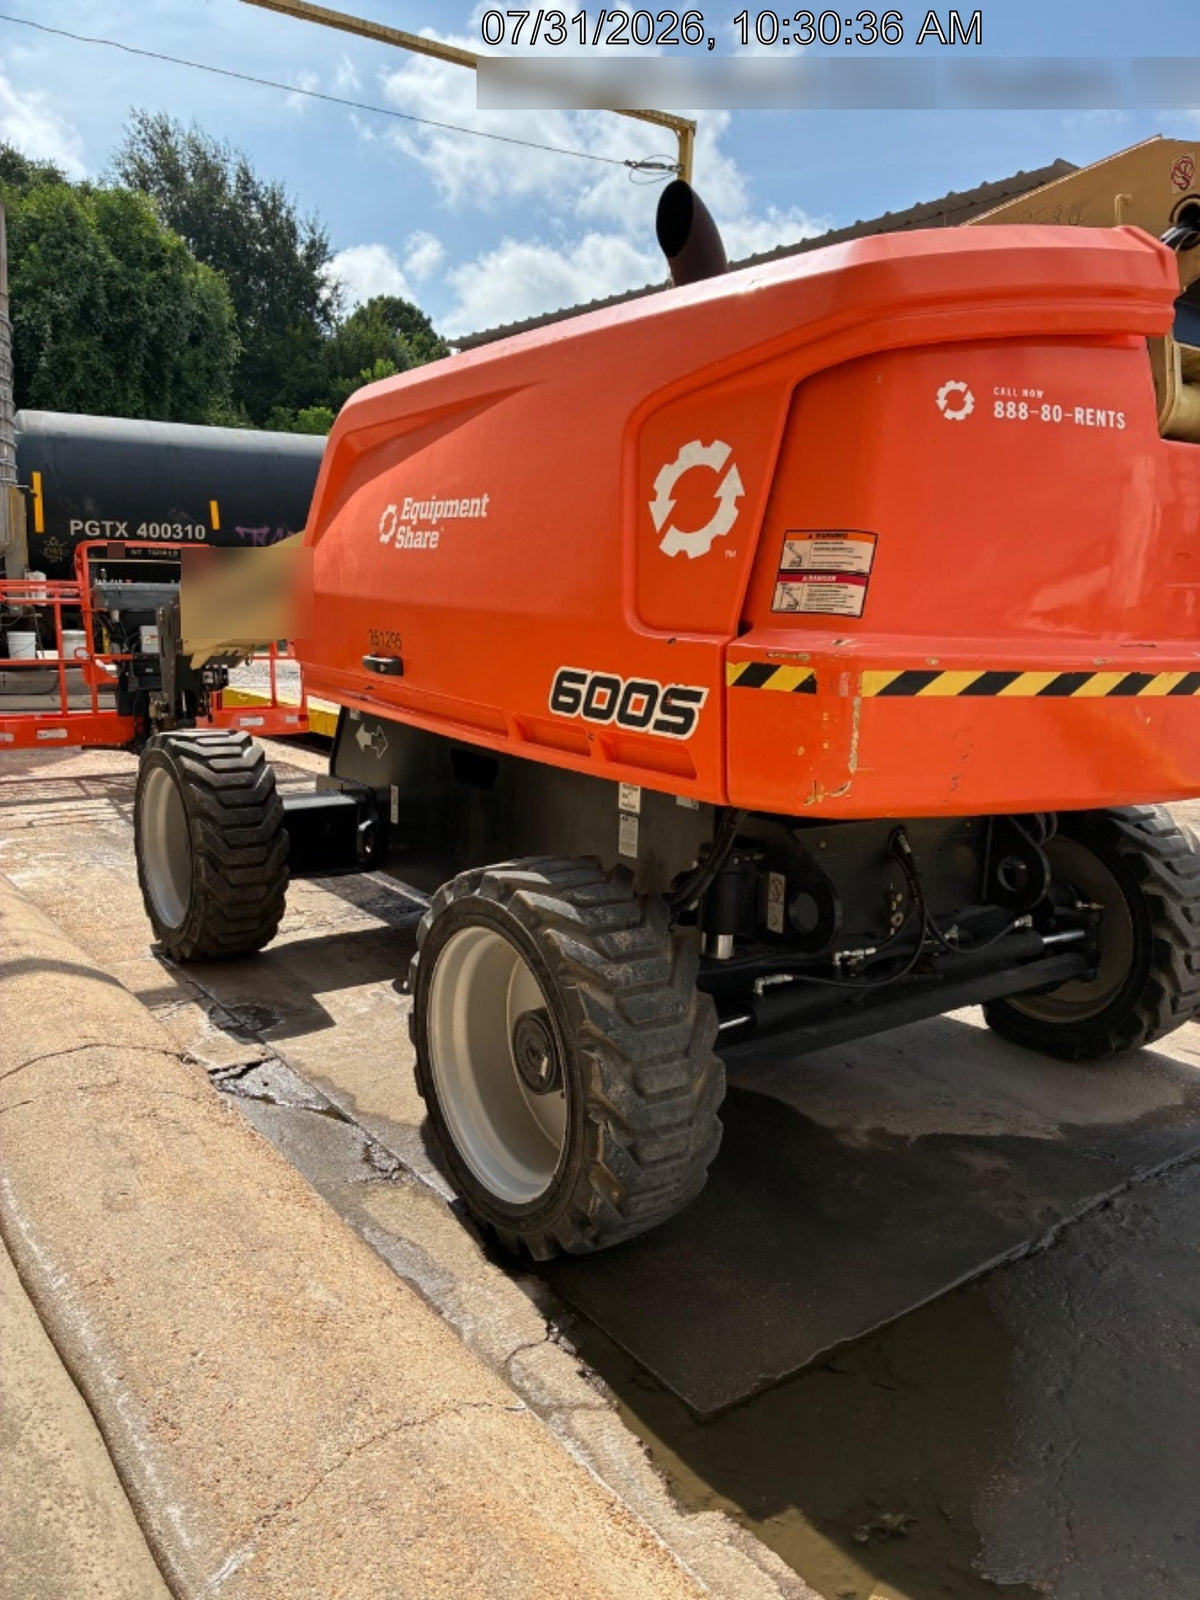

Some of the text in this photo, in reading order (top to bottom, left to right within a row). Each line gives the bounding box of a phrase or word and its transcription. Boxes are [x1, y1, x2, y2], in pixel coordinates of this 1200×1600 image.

[993, 387, 1045, 400] CALL NOW
[993, 401, 1127, 430] 888-80-RENTS
[400, 493, 490, 526] Equipment
[70, 519, 206, 540] PGTX 400310
[395, 526, 440, 549] Share
[549, 666, 709, 739] 600S
